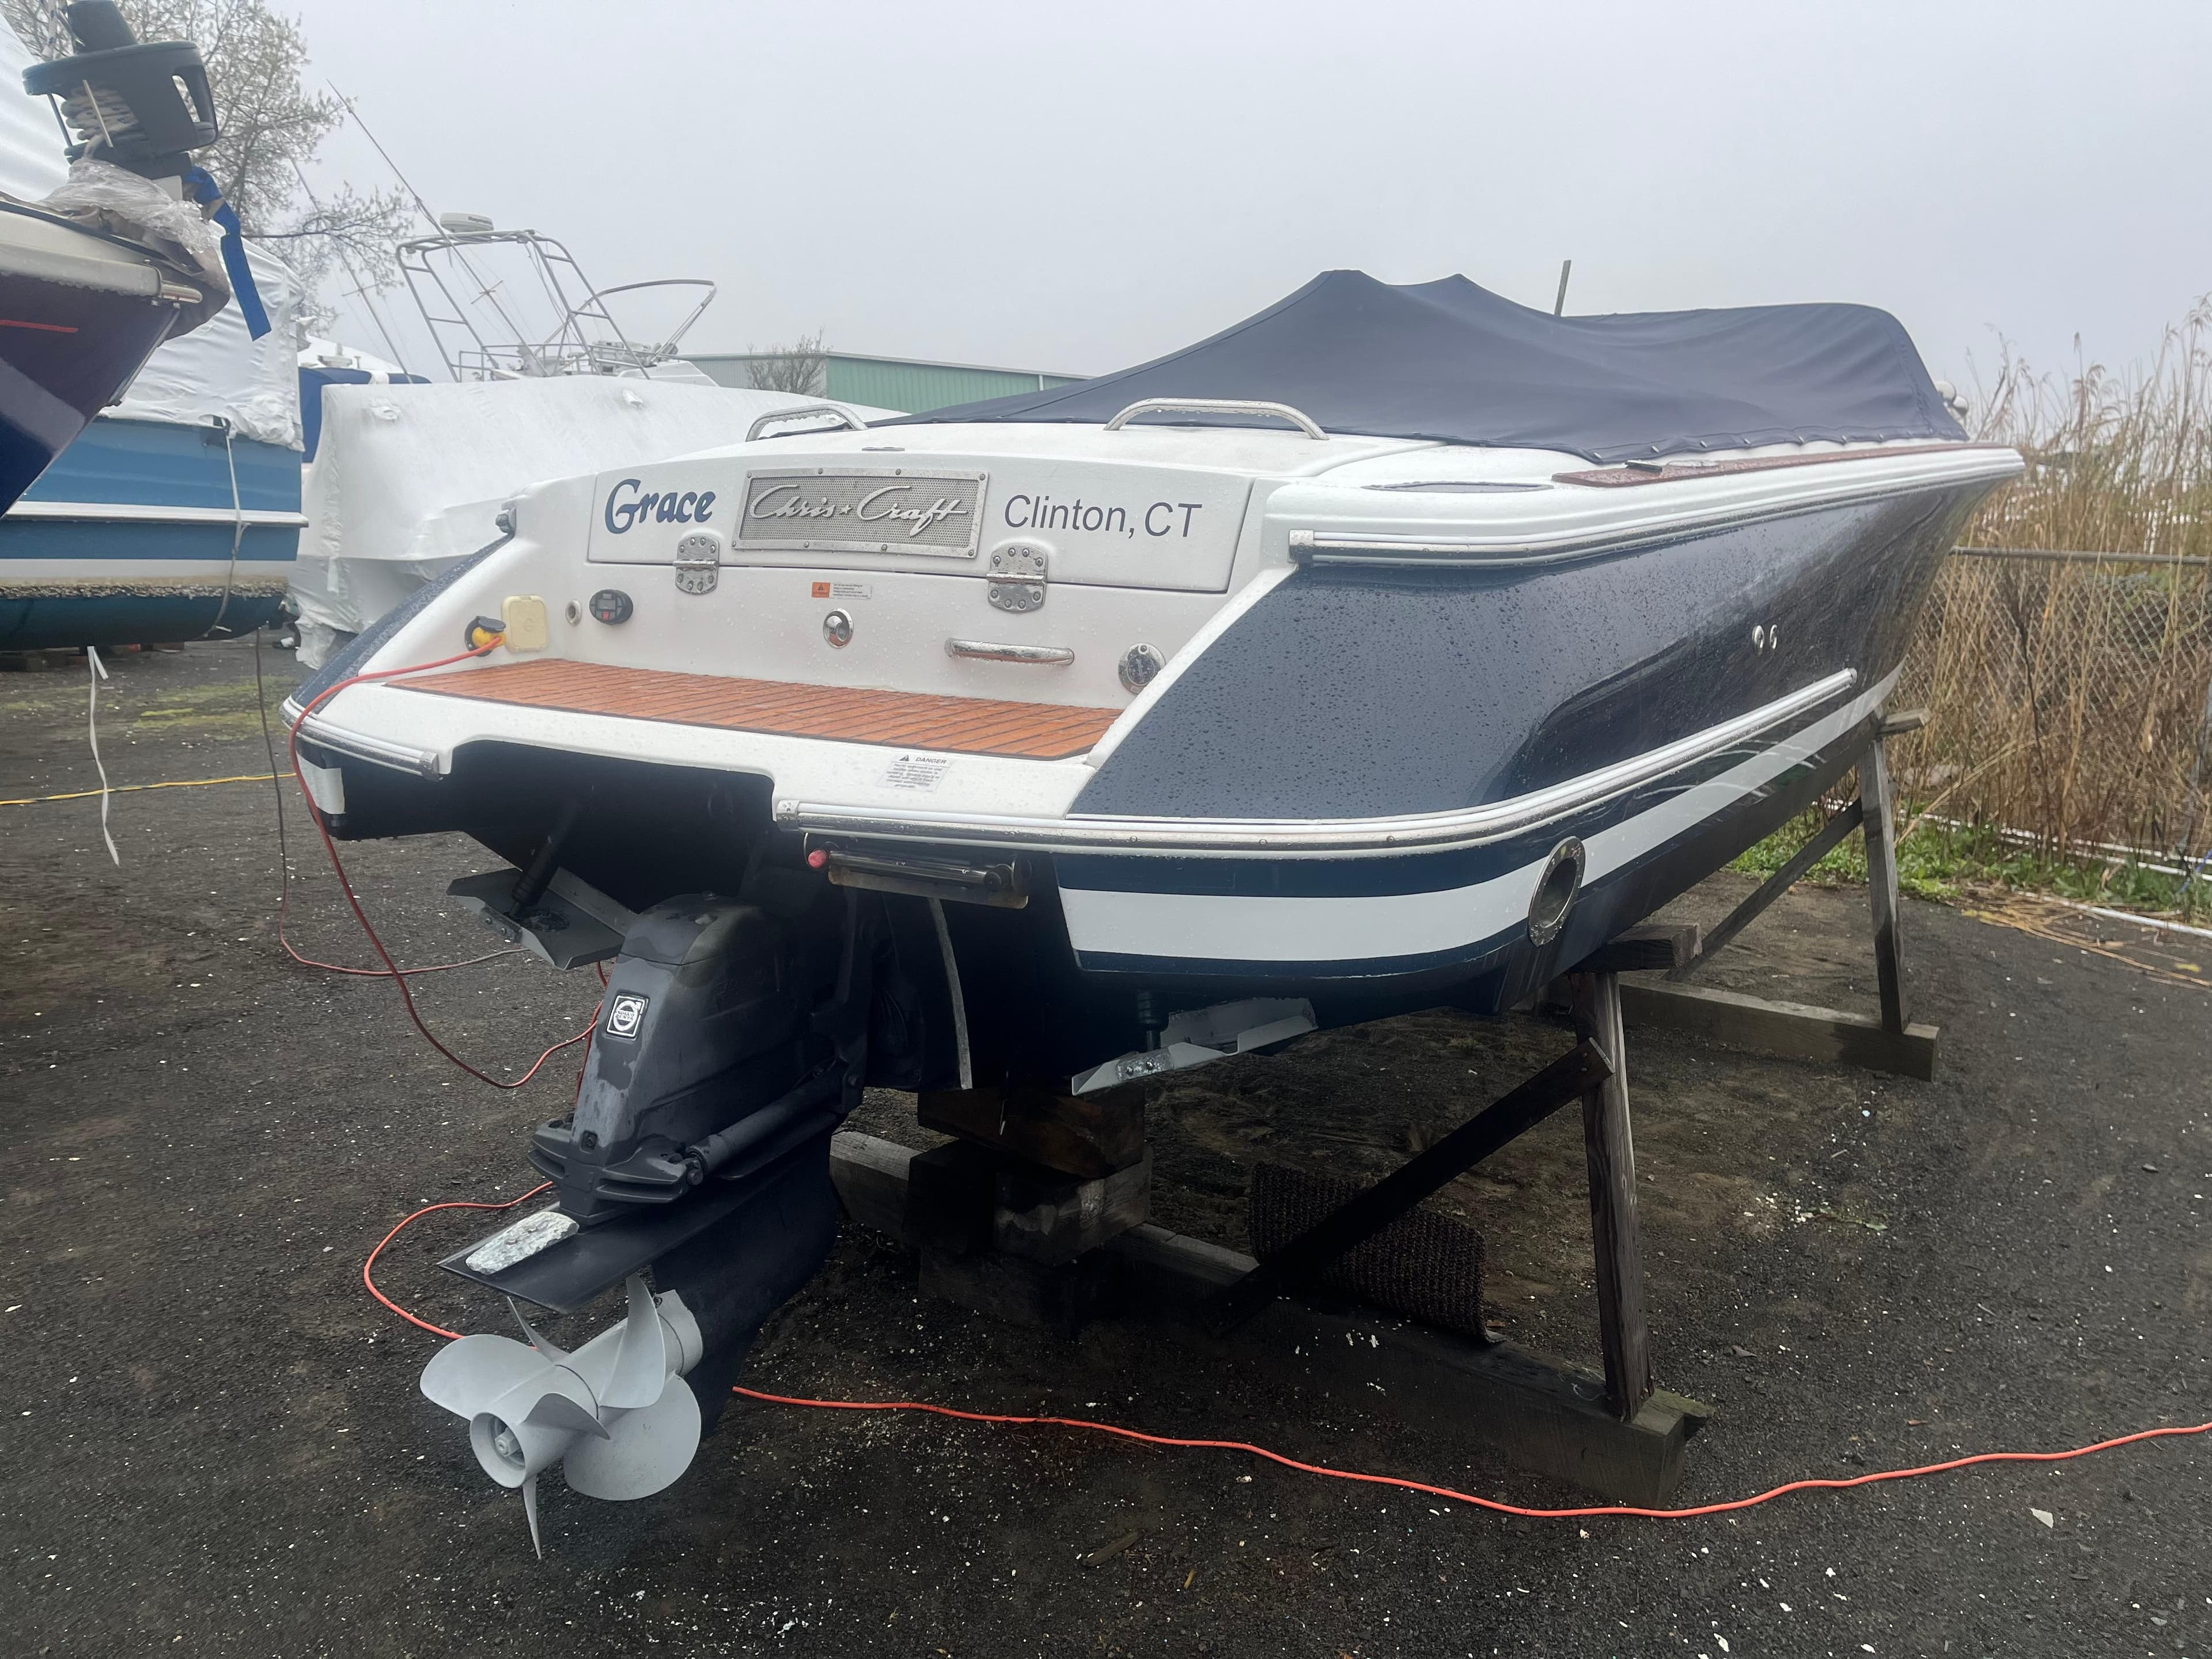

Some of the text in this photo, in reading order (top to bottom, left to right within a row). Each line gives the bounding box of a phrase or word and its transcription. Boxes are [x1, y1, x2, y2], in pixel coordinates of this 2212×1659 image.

[605, 479, 716, 534] Grace
[750, 484, 968, 537] Chris Craft
[1005, 495, 1202, 539] Clinton, CT
